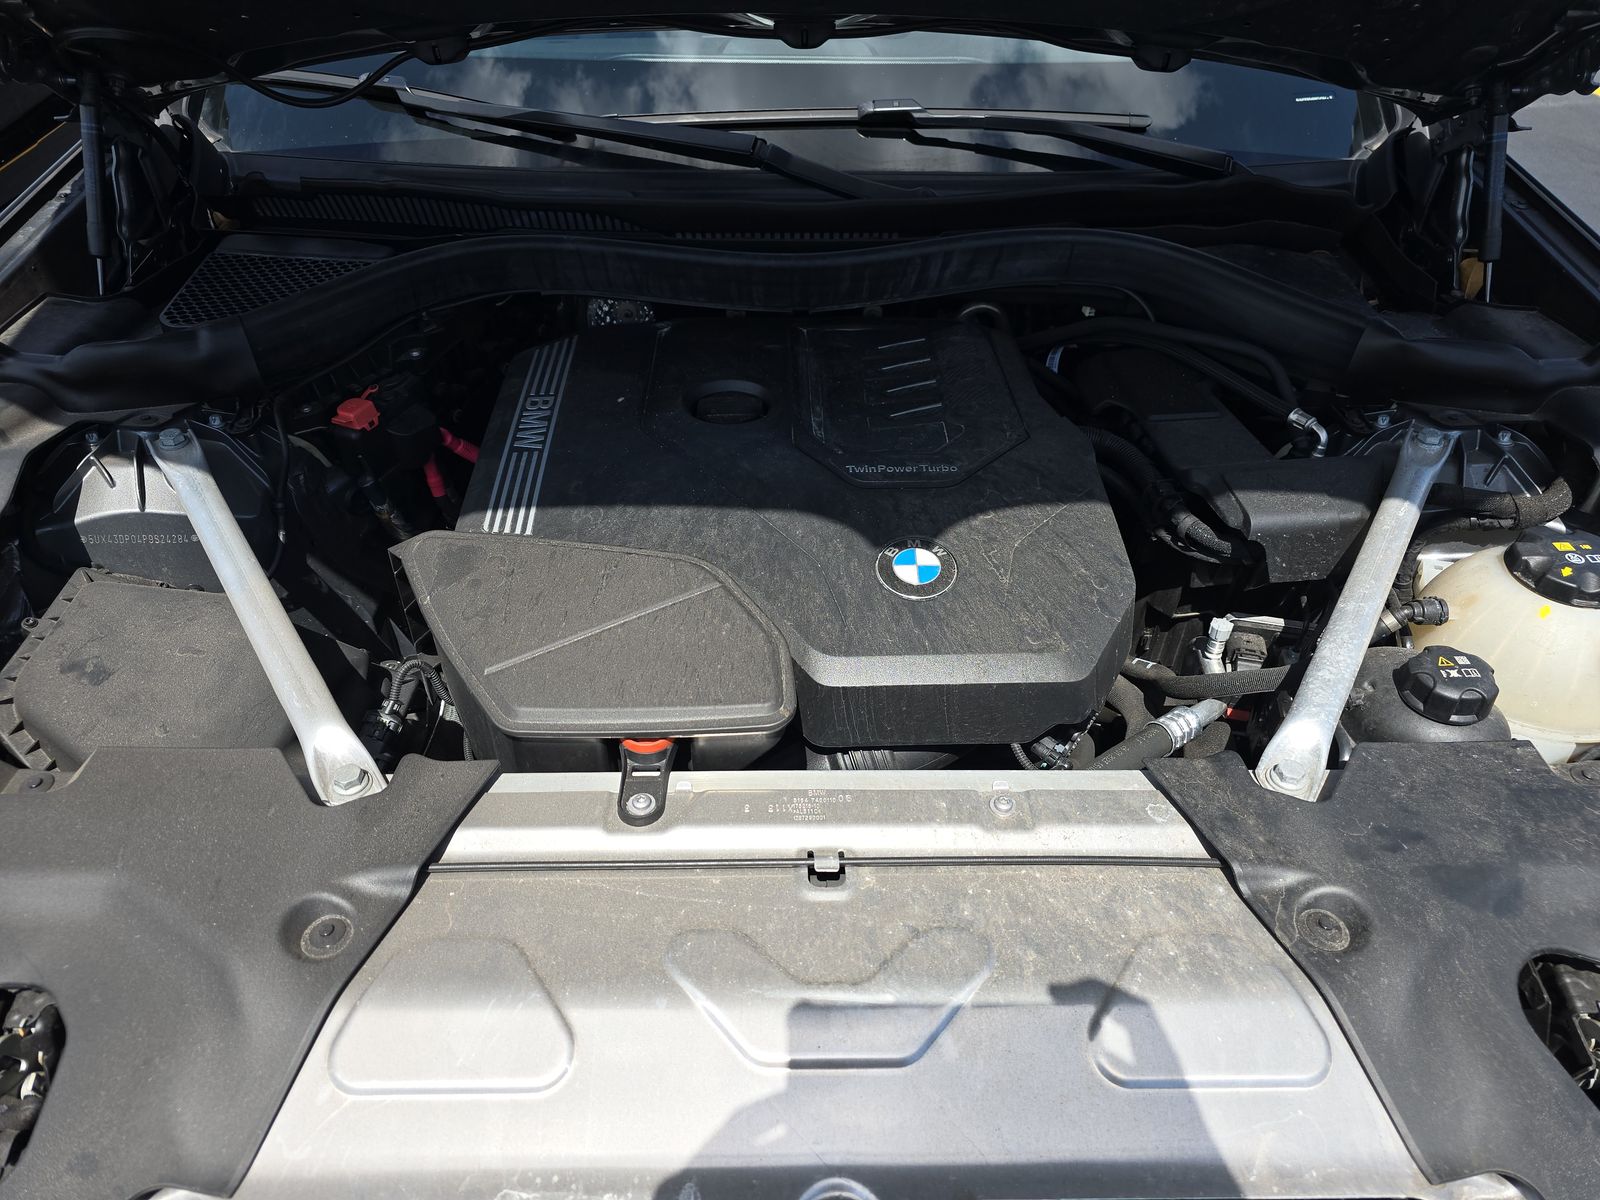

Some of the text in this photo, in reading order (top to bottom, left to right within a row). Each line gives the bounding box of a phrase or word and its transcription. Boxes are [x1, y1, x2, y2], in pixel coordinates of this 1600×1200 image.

[513, 396, 555, 448] BMW
[846, 464, 958, 473] TwinPower Turbo
[88, 534, 189, 544] 5UX43DP04P9S24284
[884, 540, 947, 557] BMW
